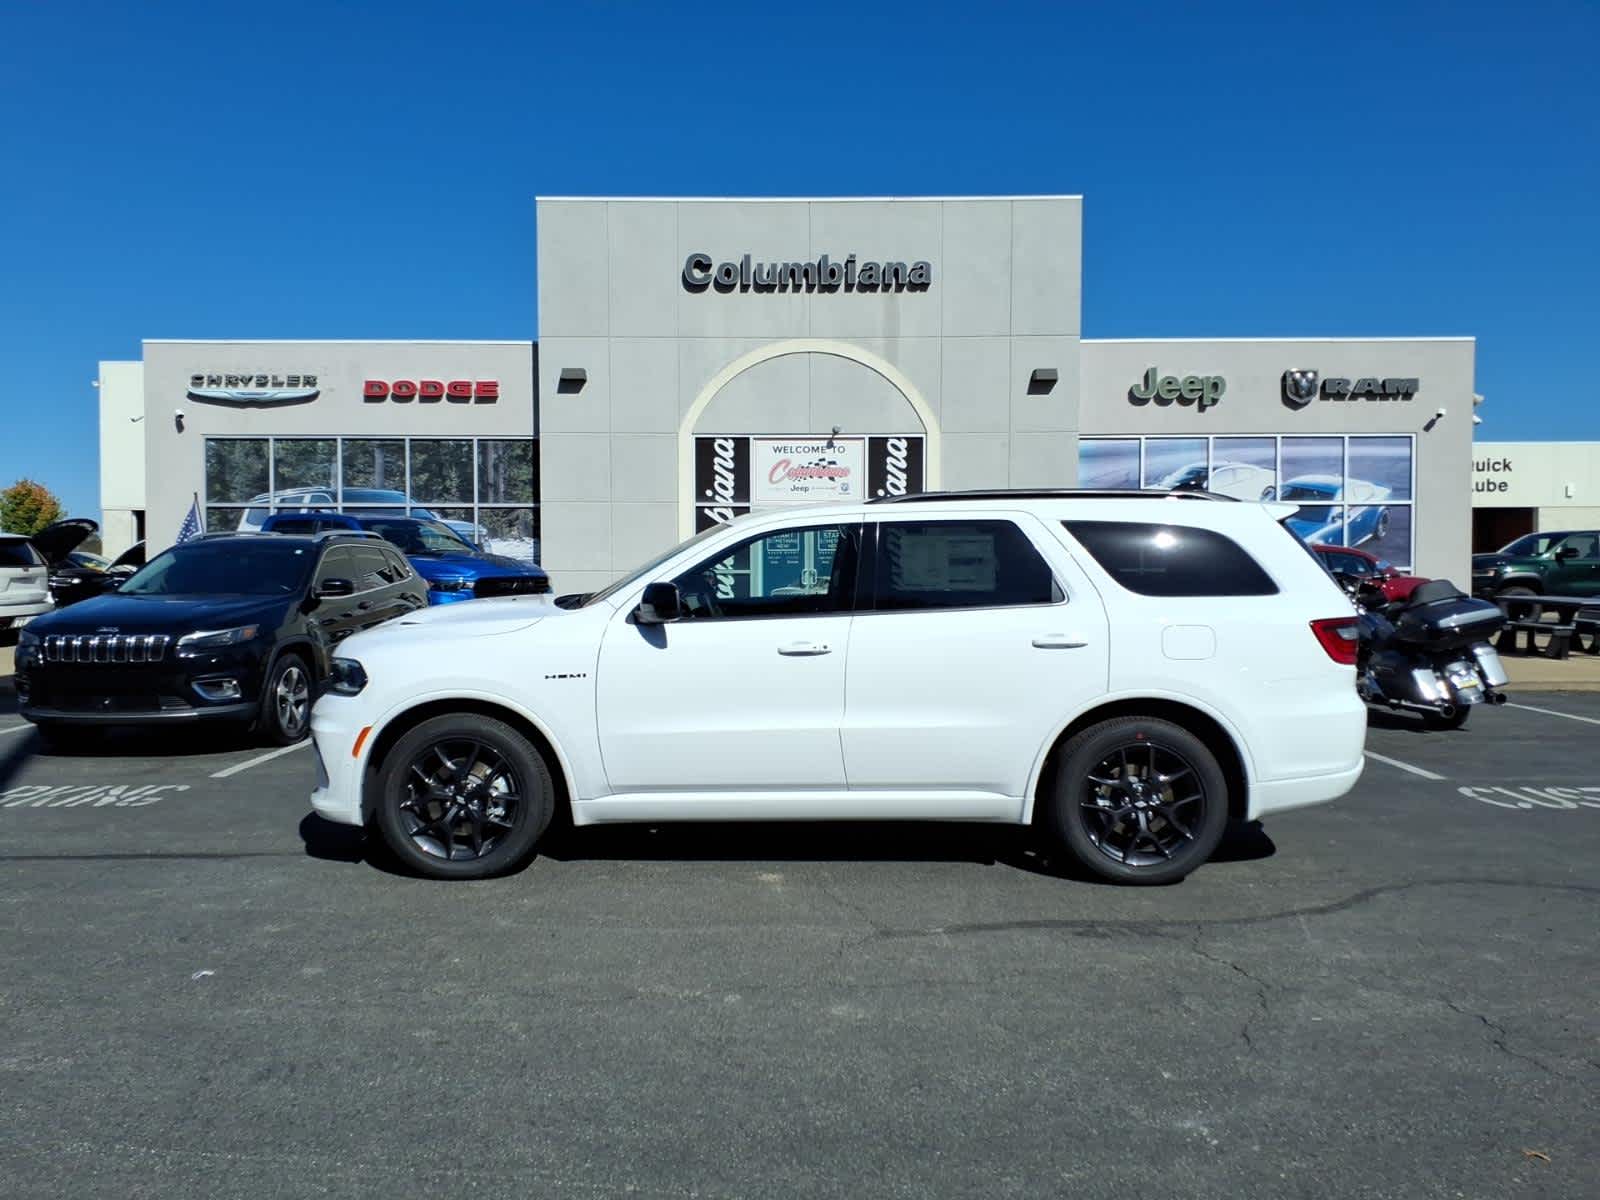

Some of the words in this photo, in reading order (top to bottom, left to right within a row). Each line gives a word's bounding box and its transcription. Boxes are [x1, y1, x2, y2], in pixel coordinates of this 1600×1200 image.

[682, 253, 932, 292] Columbiana
[191, 374, 318, 387] CHRYSLER
[1128, 367, 1226, 411] Jeep
[1321, 378, 1419, 399] RAM
[364, 380, 499, 402] DODGE
[773, 446, 827, 454] WELCOME
[832, 446, 846, 454] TO
[877, 438, 908, 498] ana
[1472, 458, 1512, 472] uick
[790, 484, 810, 494] Jeep
[1472, 478, 1508, 492] ube
